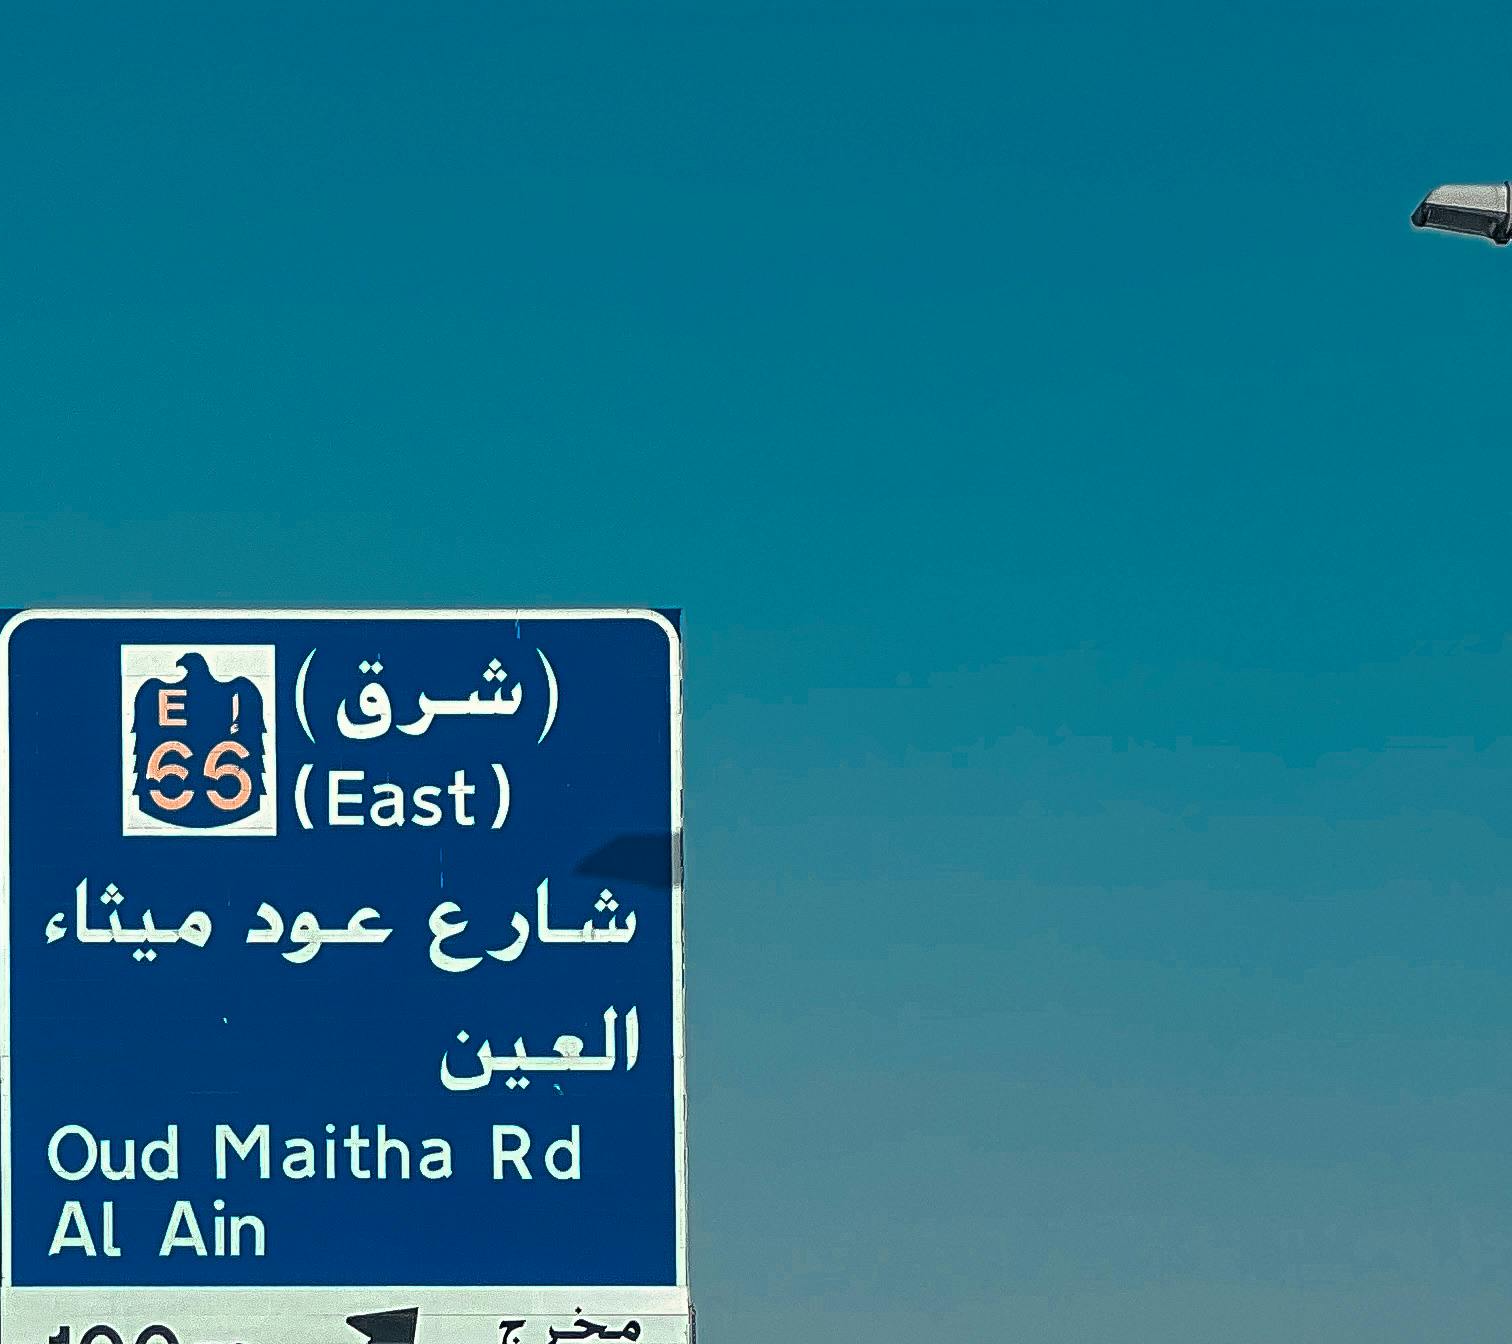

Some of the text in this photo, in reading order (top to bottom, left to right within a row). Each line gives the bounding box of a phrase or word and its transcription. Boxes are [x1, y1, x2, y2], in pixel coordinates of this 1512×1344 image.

[158, 689, 187, 726] E
[294, 647, 559, 744] (شرق)
[146, 740, 252, 811] 66
[293, 762, 511, 831] (East)
[45, 877, 637, 973] شارع عود ميثاء
[439, 1004, 639, 1091] العين
[47, 1122, 582, 1181] Oud Maitha Rd
[47, 1198, 266, 1257] Al Ain
